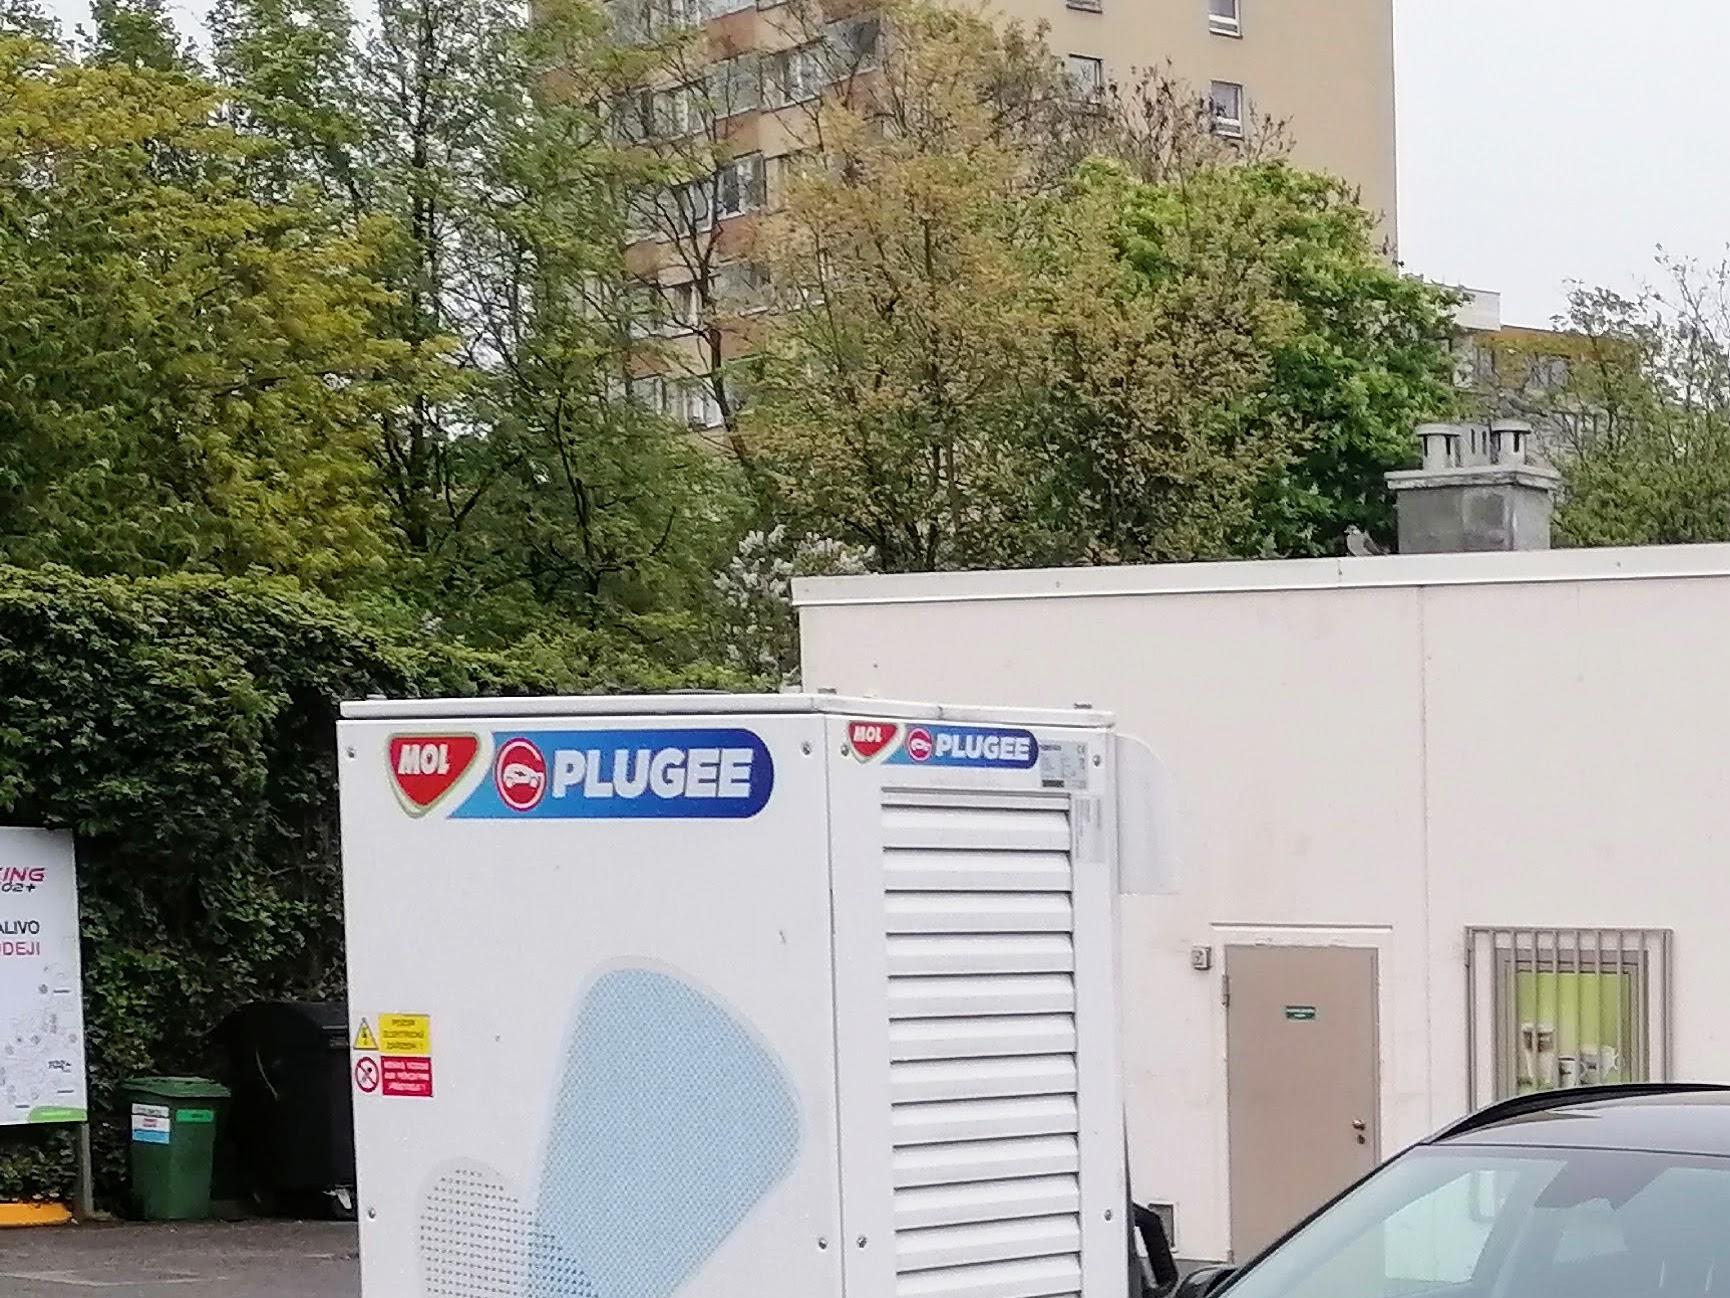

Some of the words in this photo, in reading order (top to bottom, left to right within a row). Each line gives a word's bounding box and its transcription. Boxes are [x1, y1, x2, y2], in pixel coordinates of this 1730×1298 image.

[853, 725, 883, 743] MOL
[935, 733, 1031, 761] PLUGEE
[398, 743, 451, 776] MOL
[552, 747, 754, 799] PLUGEE
[0, 867, 46, 882] ING
[0, 941, 41, 956] DEJI
